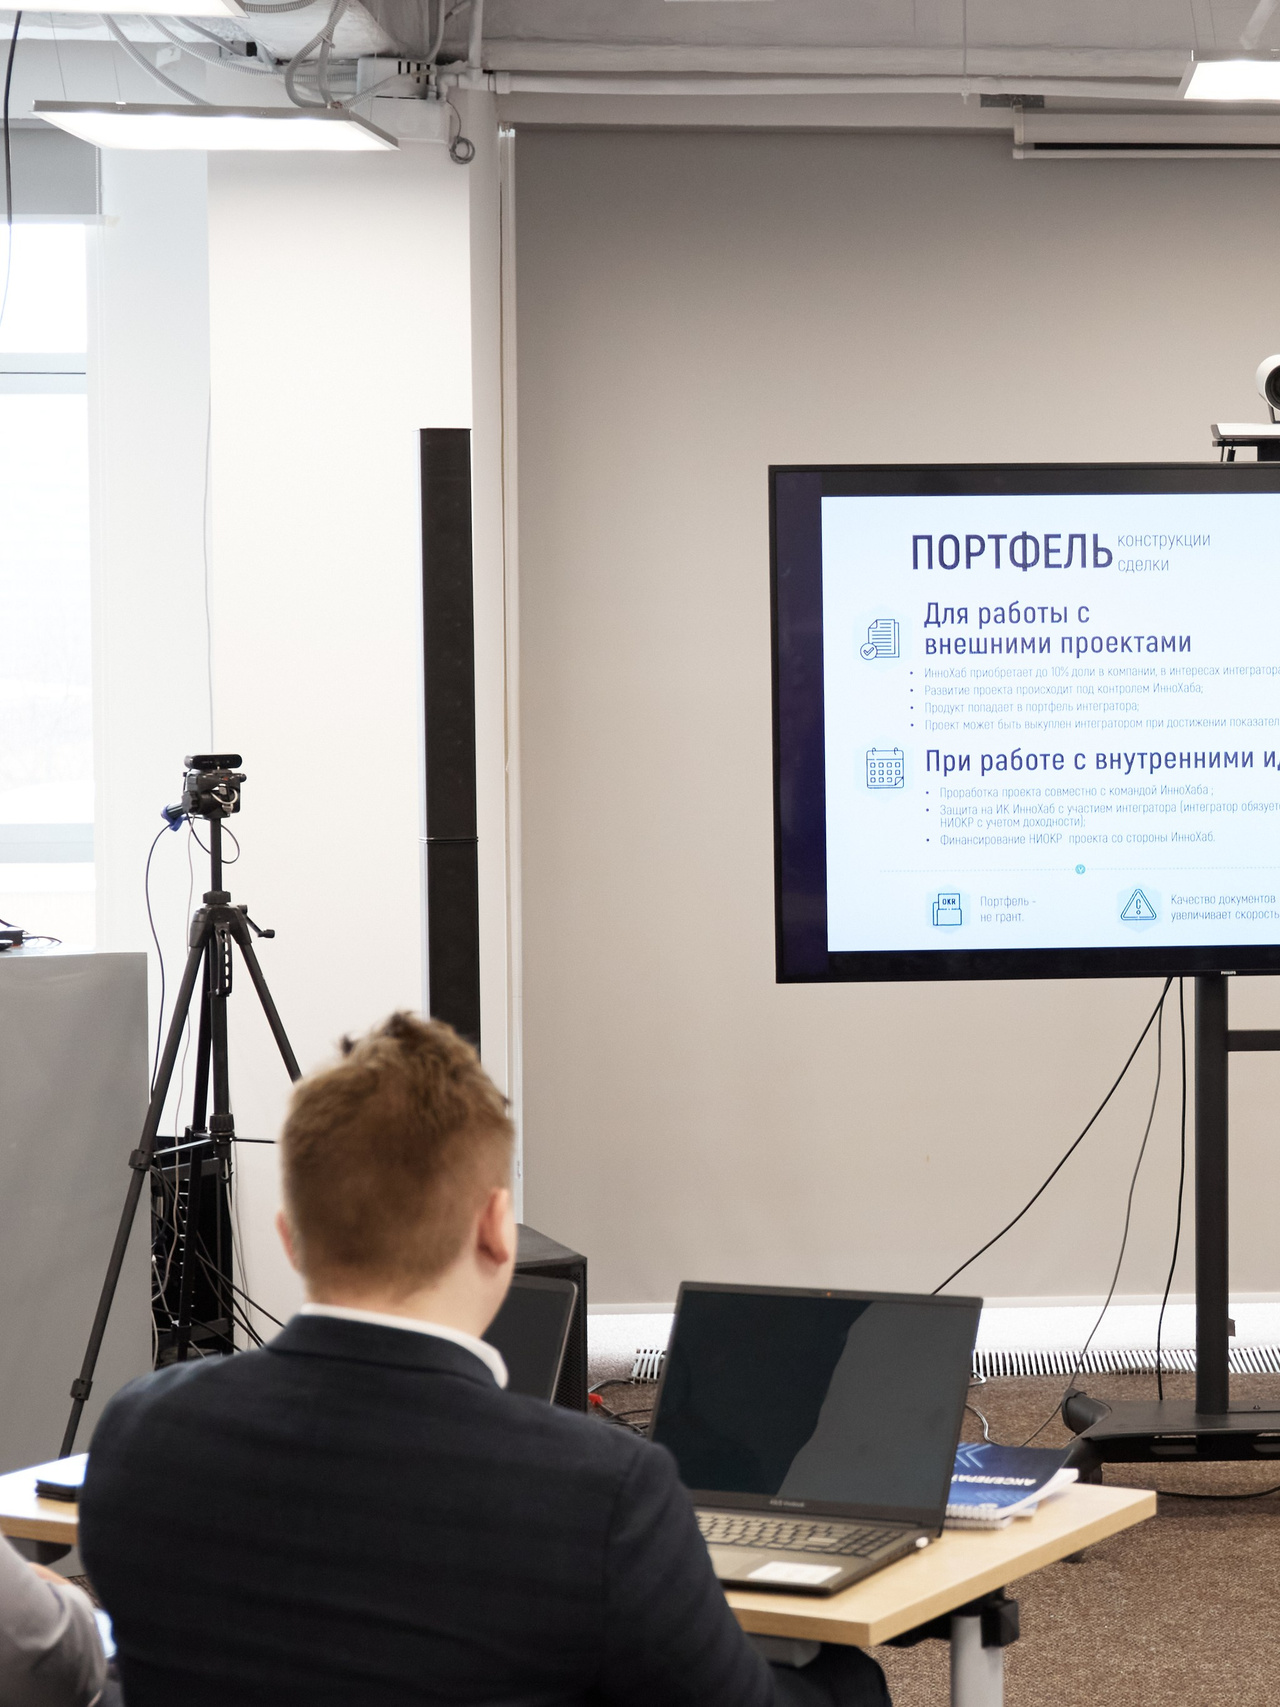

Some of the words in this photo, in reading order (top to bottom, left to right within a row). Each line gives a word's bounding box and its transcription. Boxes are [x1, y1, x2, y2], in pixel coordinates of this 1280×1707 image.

[1117, 532, 1210, 549] конструкции
[913, 531, 1113, 572] ПОРТФЕЛЬ
[1118, 558, 1169, 573] сделки
[924, 602, 968, 627] Для
[979, 600, 1067, 629] работы
[1077, 606, 1090, 623] с
[925, 637, 1051, 654] внешними
[1061, 635, 1191, 658] проектами
[925, 667, 966, 678] ИнноХаб
[971, 667, 1032, 680] приобретает
[1036, 668, 1047, 679] до
[1051, 667, 1069, 677] 10%
[1072, 667, 1095, 678] доли
[1099, 668, 1104, 676] в
[1108, 667, 1157, 677] компании,
[1161, 667, 1166, 676] в
[1170, 667, 1220, 678] интересах
[925, 686, 970, 695] Развитие
[974, 686, 1012, 697] проекта
[1017, 686, 1073, 696] происходит
[1077, 686, 1094, 695] под
[1098, 685, 1149, 695] контролем
[1153, 682, 1203, 694] ИнноХаба;
[925, 703, 964, 714] Продукт
[968, 703, 1013, 713] попадает
[1017, 704, 1022, 712] в
[1026, 702, 1073, 714] портфель
[1077, 702, 1139, 712] интегратора;
[925, 720, 959, 732] Проект
[963, 721, 994, 730] может
[998, 719, 1021, 729] быть
[1025, 720, 1071, 730] выкуплен
[1075, 719, 1142, 730] интегратором
[1146, 719, 1164, 729] при
[1167, 718, 1226, 728] достижении
[926, 750, 970, 776] При
[981, 748, 1064, 776] работе
[1074, 753, 1086, 770] с
[1096, 750, 1253, 774] внутренними
[940, 787, 998, 799] Проработка
[1002, 788, 1041, 798] проекта
[1045, 787, 1097, 796] совместно
[1100, 787, 1105, 795] с
[1109, 786, 1157, 796] командой
[1161, 785, 1209, 796] ИнноХаба
[940, 805, 977, 815] Защита
[981, 806, 992, 814] на
[996, 805, 1009, 814] ИК
[1013, 804, 1055, 814] ИнноХаб
[1068, 805, 1112, 815] участием
[1116, 802, 1177, 813] интегратора
[1180, 801, 1238, 813] (интегратор
[941, 817, 974, 828] НИОКР
[977, 819, 982, 827] с
[986, 819, 1020, 829] учетом
[940, 834, 1025, 847] Финансирование
[1029, 834, 1062, 844] НИОКР
[1069, 834, 1107, 844] проекта
[1112, 834, 1122, 842] со
[1126, 833, 1168, 844] стороны
[1171, 832, 1215, 842] ИнноХаб.
[981, 896, 1029, 908] Портфель
[1171, 895, 1215, 904] Качество
[1219, 895, 1276, 906] документов
[981, 914, 991, 922] не
[996, 913, 1024, 923] грант.
[1171, 911, 1231, 922] увеличивает
[1235, 911, 1279, 921] скорость
